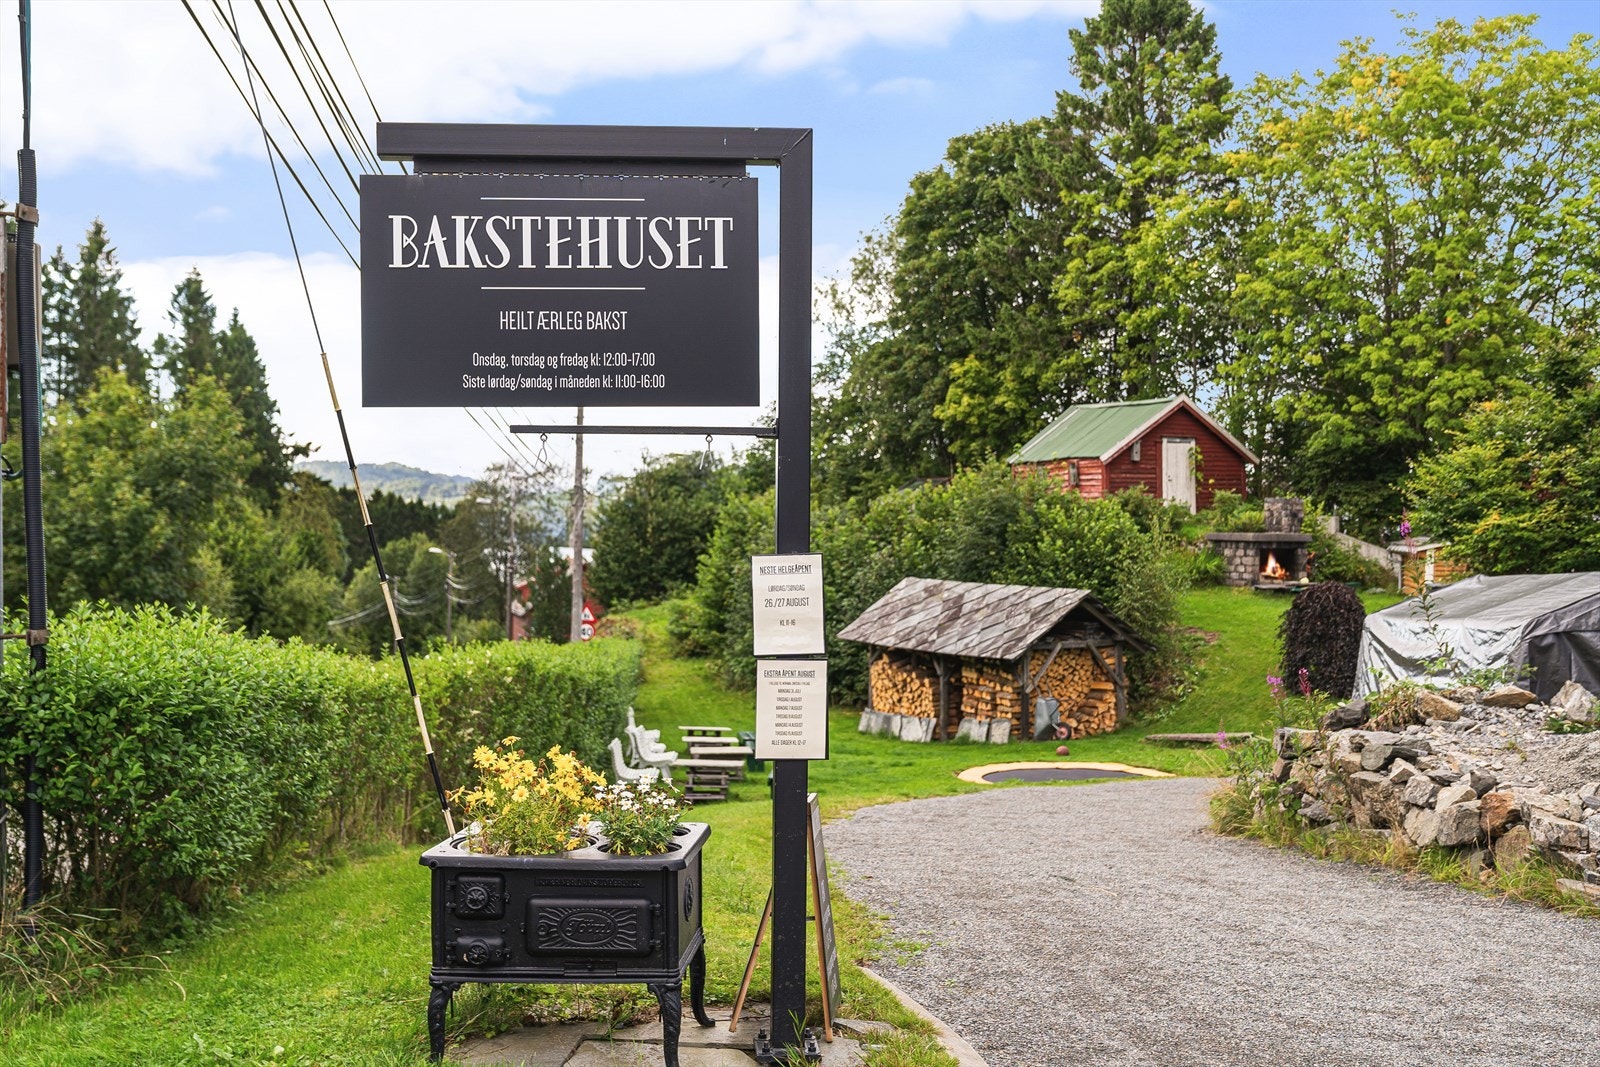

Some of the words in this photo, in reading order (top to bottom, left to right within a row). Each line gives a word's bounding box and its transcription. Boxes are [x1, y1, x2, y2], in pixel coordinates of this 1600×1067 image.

[388, 214, 734, 270] BAKSTEHUSET
[499, 310, 535, 330] HEILT
[536, 310, 583, 330] ÆRLEG
[586, 310, 628, 330] BAKST
[472, 352, 509, 369] Onsdag,
[511, 352, 545, 369] torsdag
[547, 357, 558, 369] og
[560, 352, 589, 369] fredag
[590, 352, 601, 367] kl:
[603, 352, 656, 367] 12:00-17:00
[462, 374, 486, 389] Siste
[487, 374, 553, 391] lørdag/søndag
[554, 374, 558, 389] i
[559, 373, 601, 389] måneden
[602, 374, 614, 389] kl:
[615, 374, 666, 389] 11:00-16:00
[759, 566, 777, 575] NESTE
[778, 564, 812, 574] HELGEÅPENT
[786, 597, 809, 607] AUGUST
[763, 670, 781, 678] EKSTRA
[782, 669, 797, 678] ÅPENT
[798, 670, 815, 678] AUGUST
